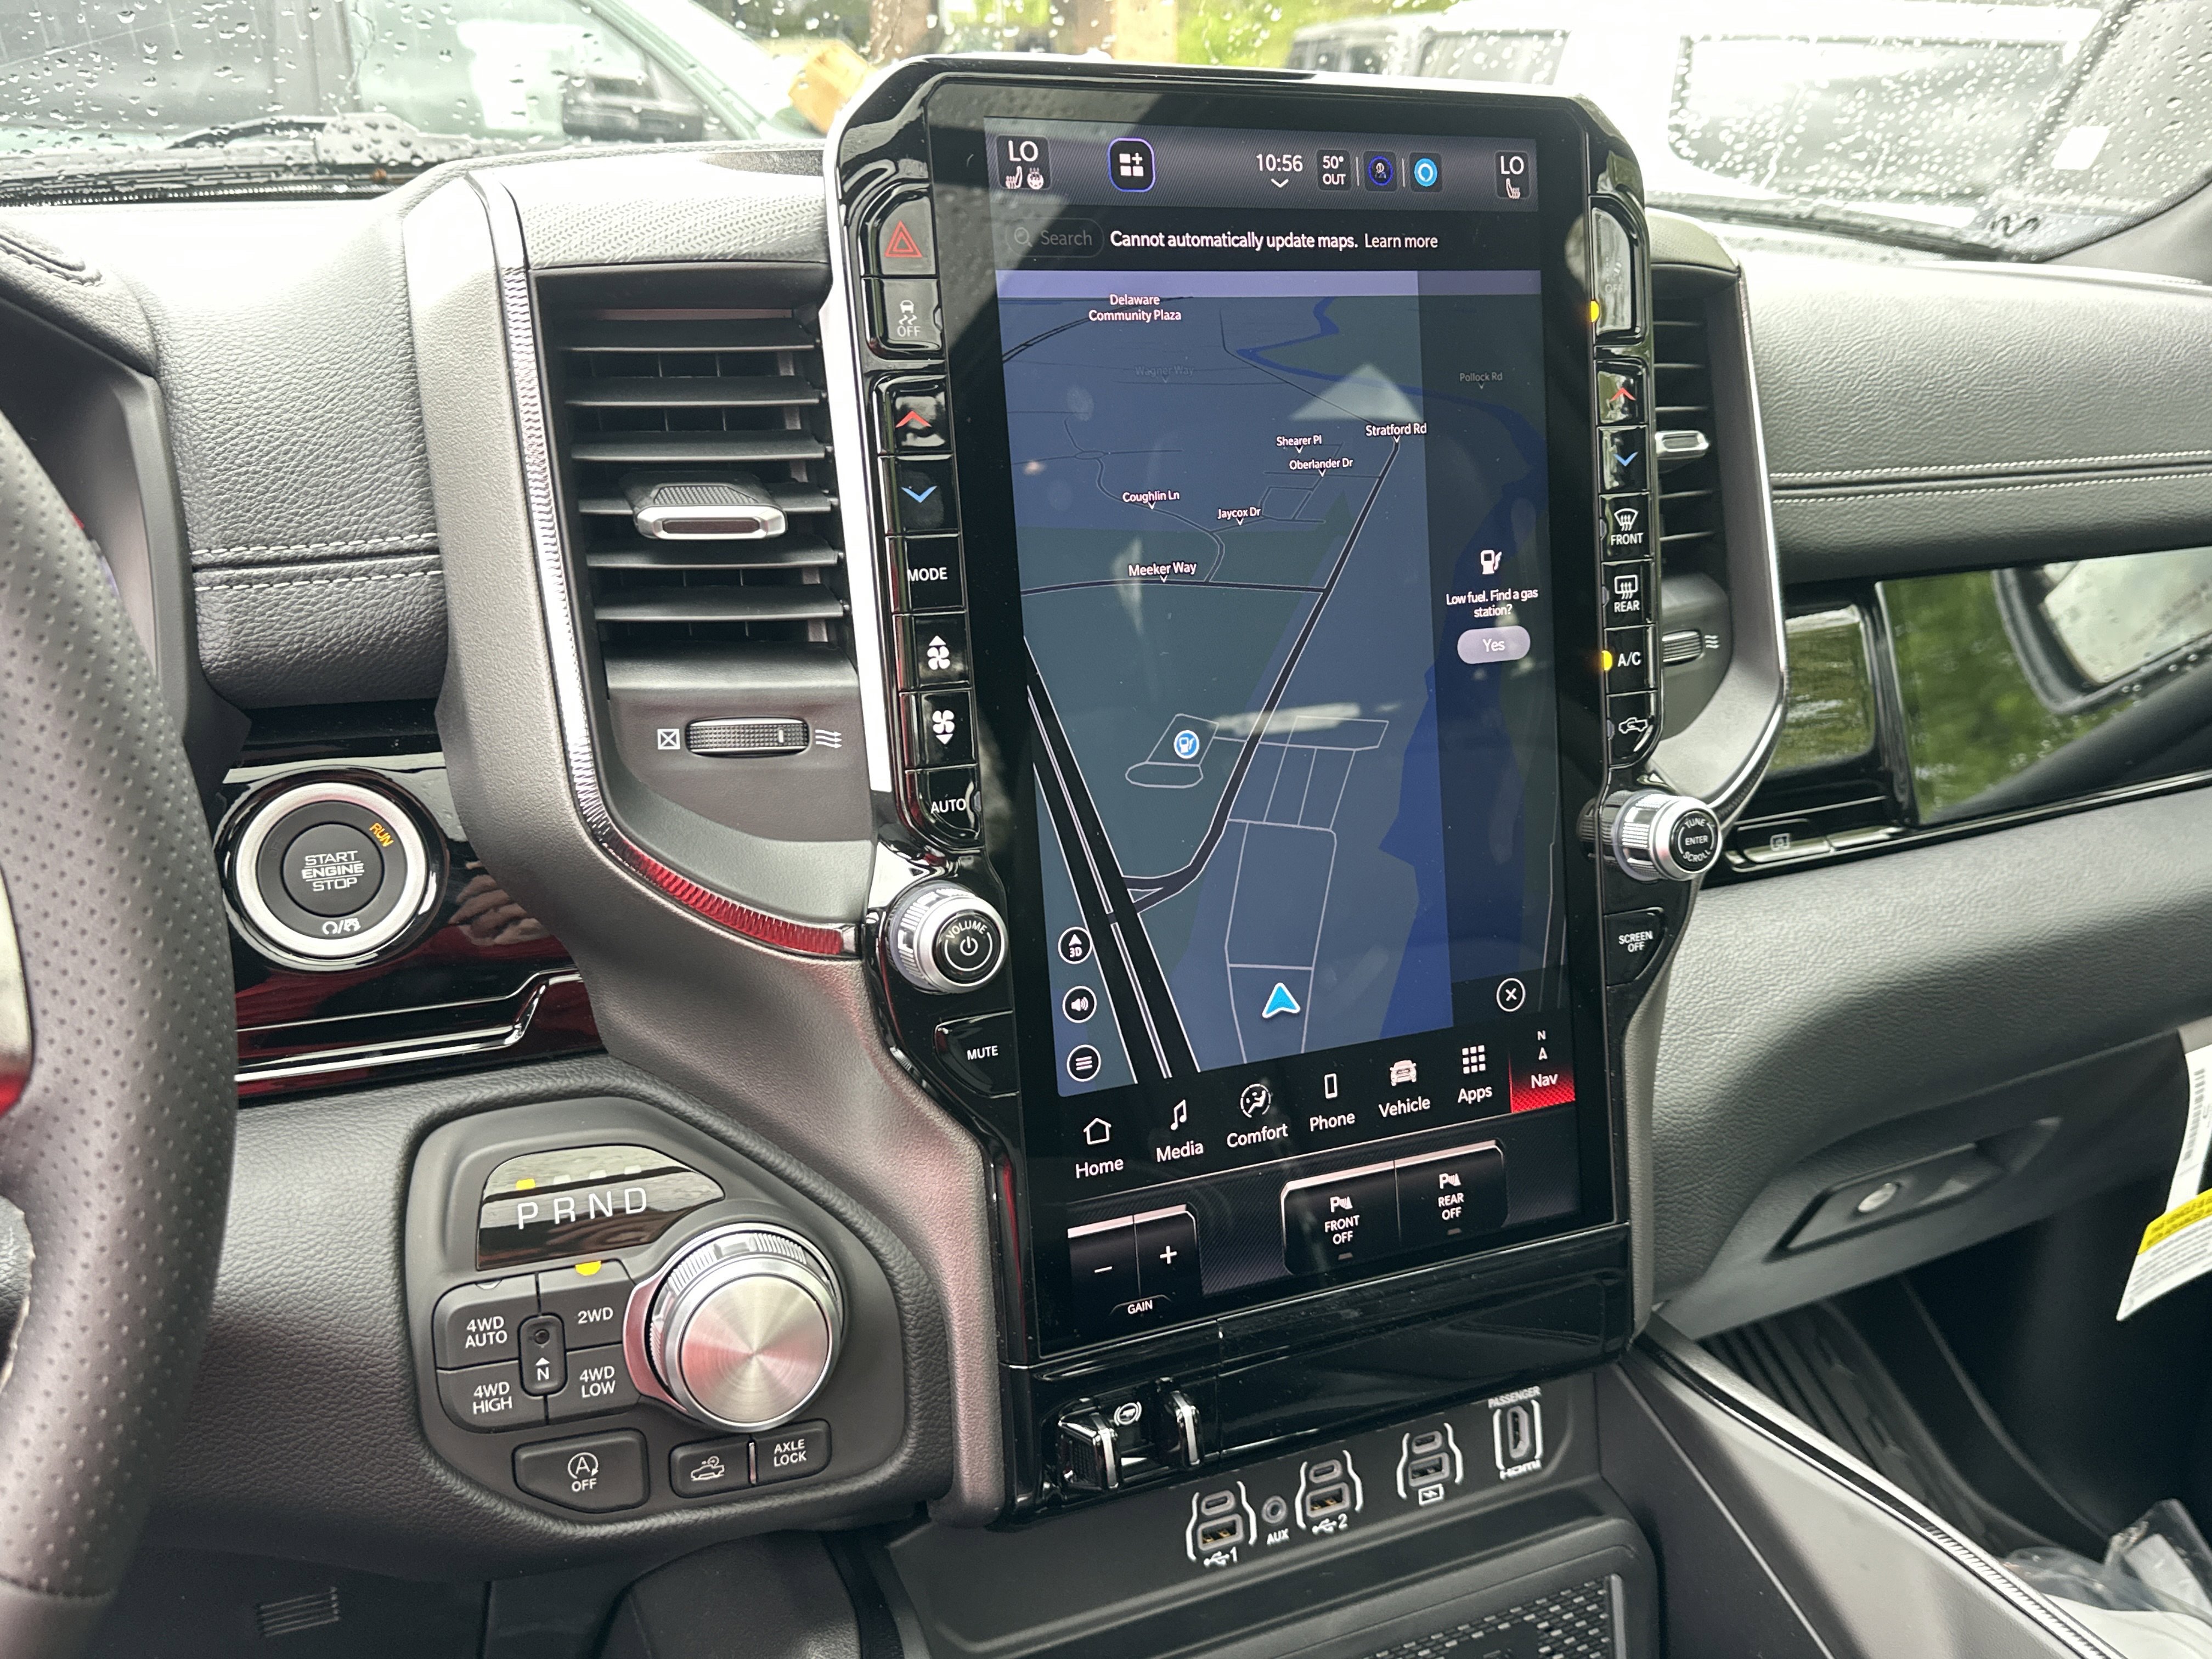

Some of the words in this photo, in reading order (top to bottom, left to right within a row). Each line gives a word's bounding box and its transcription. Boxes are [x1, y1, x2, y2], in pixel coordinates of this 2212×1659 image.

[1008, 140, 1039, 162] LO
[1256, 154, 1303, 173] 10:56
[1322, 155, 1344, 170] 50°
[1500, 156, 1523, 175] LO
[1322, 173, 1346, 185] OUT
[1040, 229, 1092, 247] Search
[1110, 230, 1164, 247] Cannot
[1167, 232, 1263, 251] automatically
[1266, 233, 1314, 251] update
[1318, 235, 1358, 251] maps.
[1364, 233, 1401, 249] Learn
[1403, 237, 1438, 249] more
[1109, 294, 1160, 305] Delaware
[1088, 309, 1152, 323] Community
[1154, 309, 1181, 320] Plaza
[897, 325, 921, 337] OFF
[1460, 372, 1488, 382] Pollock
[1490, 372, 1503, 382] Rd
[1365, 423, 1410, 436] Stratford
[1413, 422, 1427, 434] Rd
[1276, 436, 1311, 447] Shearer
[1312, 435, 1322, 445] Pl
[1289, 458, 1340, 470] Oberlander
[1341, 458, 1353, 468] Dr
[1122, 491, 1166, 503] Coughlin
[1169, 490, 1180, 501] Ln
[1217, 508, 1248, 520] Jaycox
[1249, 507, 1261, 517] Dr
[1610, 532, 1644, 546] FRONT
[907, 567, 948, 582] MODE
[1128, 563, 1170, 577] Meeker
[1172, 562, 1197, 575] Way
[1446, 593, 1465, 605] Low
[1467, 591, 1488, 605] fuel.
[1490, 590, 1511, 602] Find
[1520, 590, 1539, 603] gas
[1474, 604, 1513, 618] station?
[1614, 600, 1640, 613] REAR
[1483, 638, 1505, 652] Yes
[1618, 652, 1641, 667] A/C
[931, 798, 966, 814] AUTO
[1684, 817, 1707, 830] TUNE
[369, 822, 394, 847] RUN
[1685, 834, 1708, 846] ENTER
[304, 850, 358, 866] START
[1683, 849, 1712, 863] SCROLL
[302, 863, 365, 879] ENGINE
[313, 877, 358, 892] STOP
[945, 919, 988, 941] VOLUME
[1618, 930, 1654, 945] SCREEN
[1069, 946, 1082, 957] 3D
[1627, 941, 1645, 953] OFF
[1537, 1030, 1546, 1040] N
[967, 1045, 998, 1060] MUTE
[1531, 1073, 1558, 1088] Nav
[1457, 1084, 1493, 1104] Apps
[1378, 1096, 1430, 1118] Vehicle
[1310, 1111, 1355, 1131] Phone
[1226, 1123, 1289, 1148] Comfort
[1156, 1141, 1204, 1163] Media
[1075, 1158, 1124, 1178] Home
[1437, 1192, 1464, 1206] REAR
[1442, 1206, 1461, 1220] OFF
[1324, 1215, 1359, 1233] FRONT
[1333, 1230, 1353, 1245] OFF
[1127, 1299, 1153, 1314] GAIN
[578, 1306, 614, 1324] 2WD
[466, 1316, 504, 1332] 4WD
[465, 1330, 508, 1348] AUTO
[538, 1366, 550, 1381] N
[579, 1365, 615, 1382] 4WD
[473, 1381, 510, 1398] 4WD
[581, 1380, 616, 1398] LOW
[1488, 1386, 1542, 1409] PASSENGER
[472, 1397, 512, 1414] HIGH
[774, 1438, 805, 1454] AXLE
[774, 1450, 807, 1467] LOCK
[571, 1477, 597, 1492] OFF
[1338, 1514, 1348, 1530] 2
[1266, 1528, 1289, 1545] AUX
